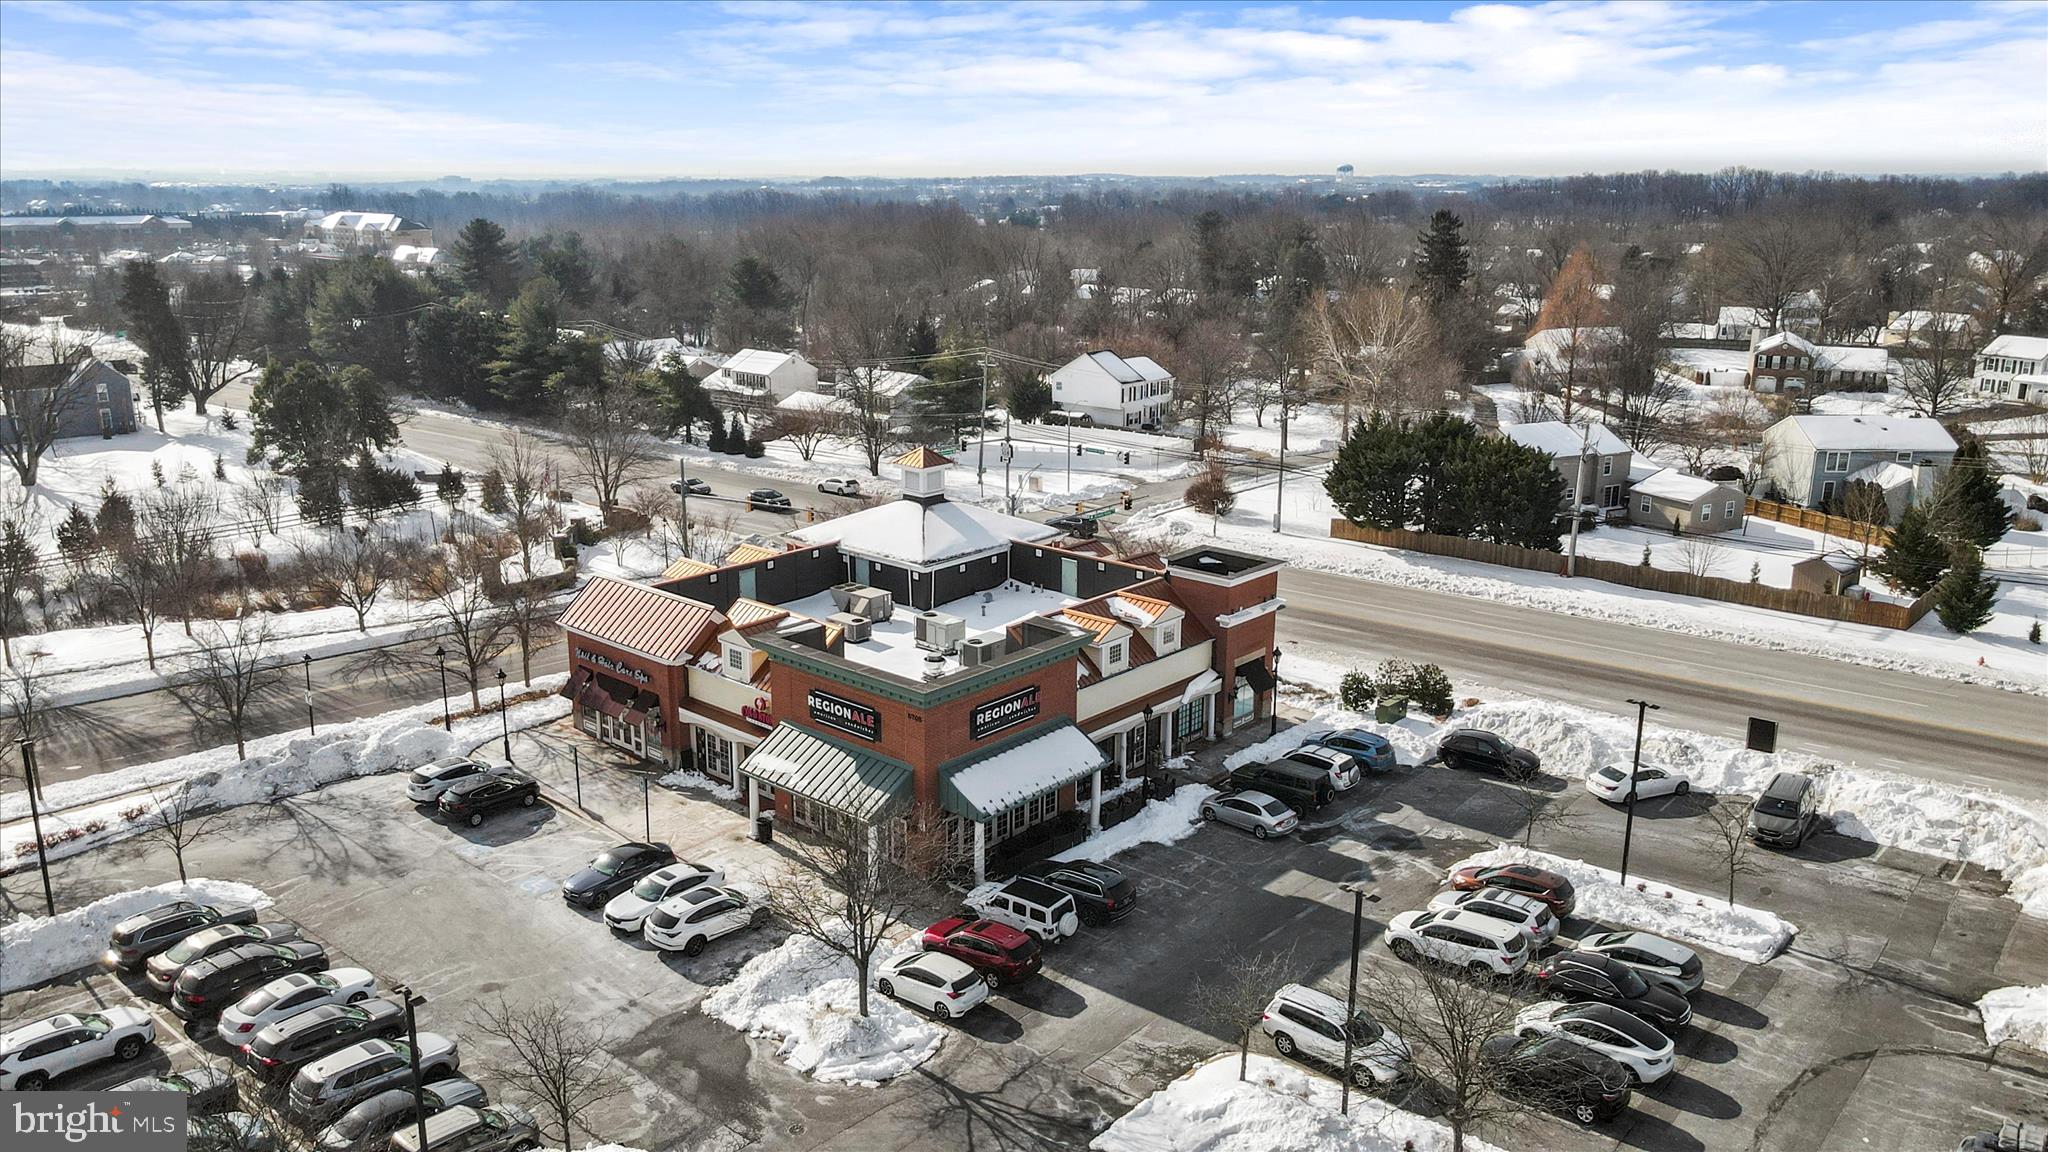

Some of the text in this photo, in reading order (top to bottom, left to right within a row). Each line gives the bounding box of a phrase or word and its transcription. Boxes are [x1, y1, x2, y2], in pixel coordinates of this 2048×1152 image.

[575, 647, 649, 684] Nail & Hair Care Spa
[807, 694, 875, 727] REGIONALE
